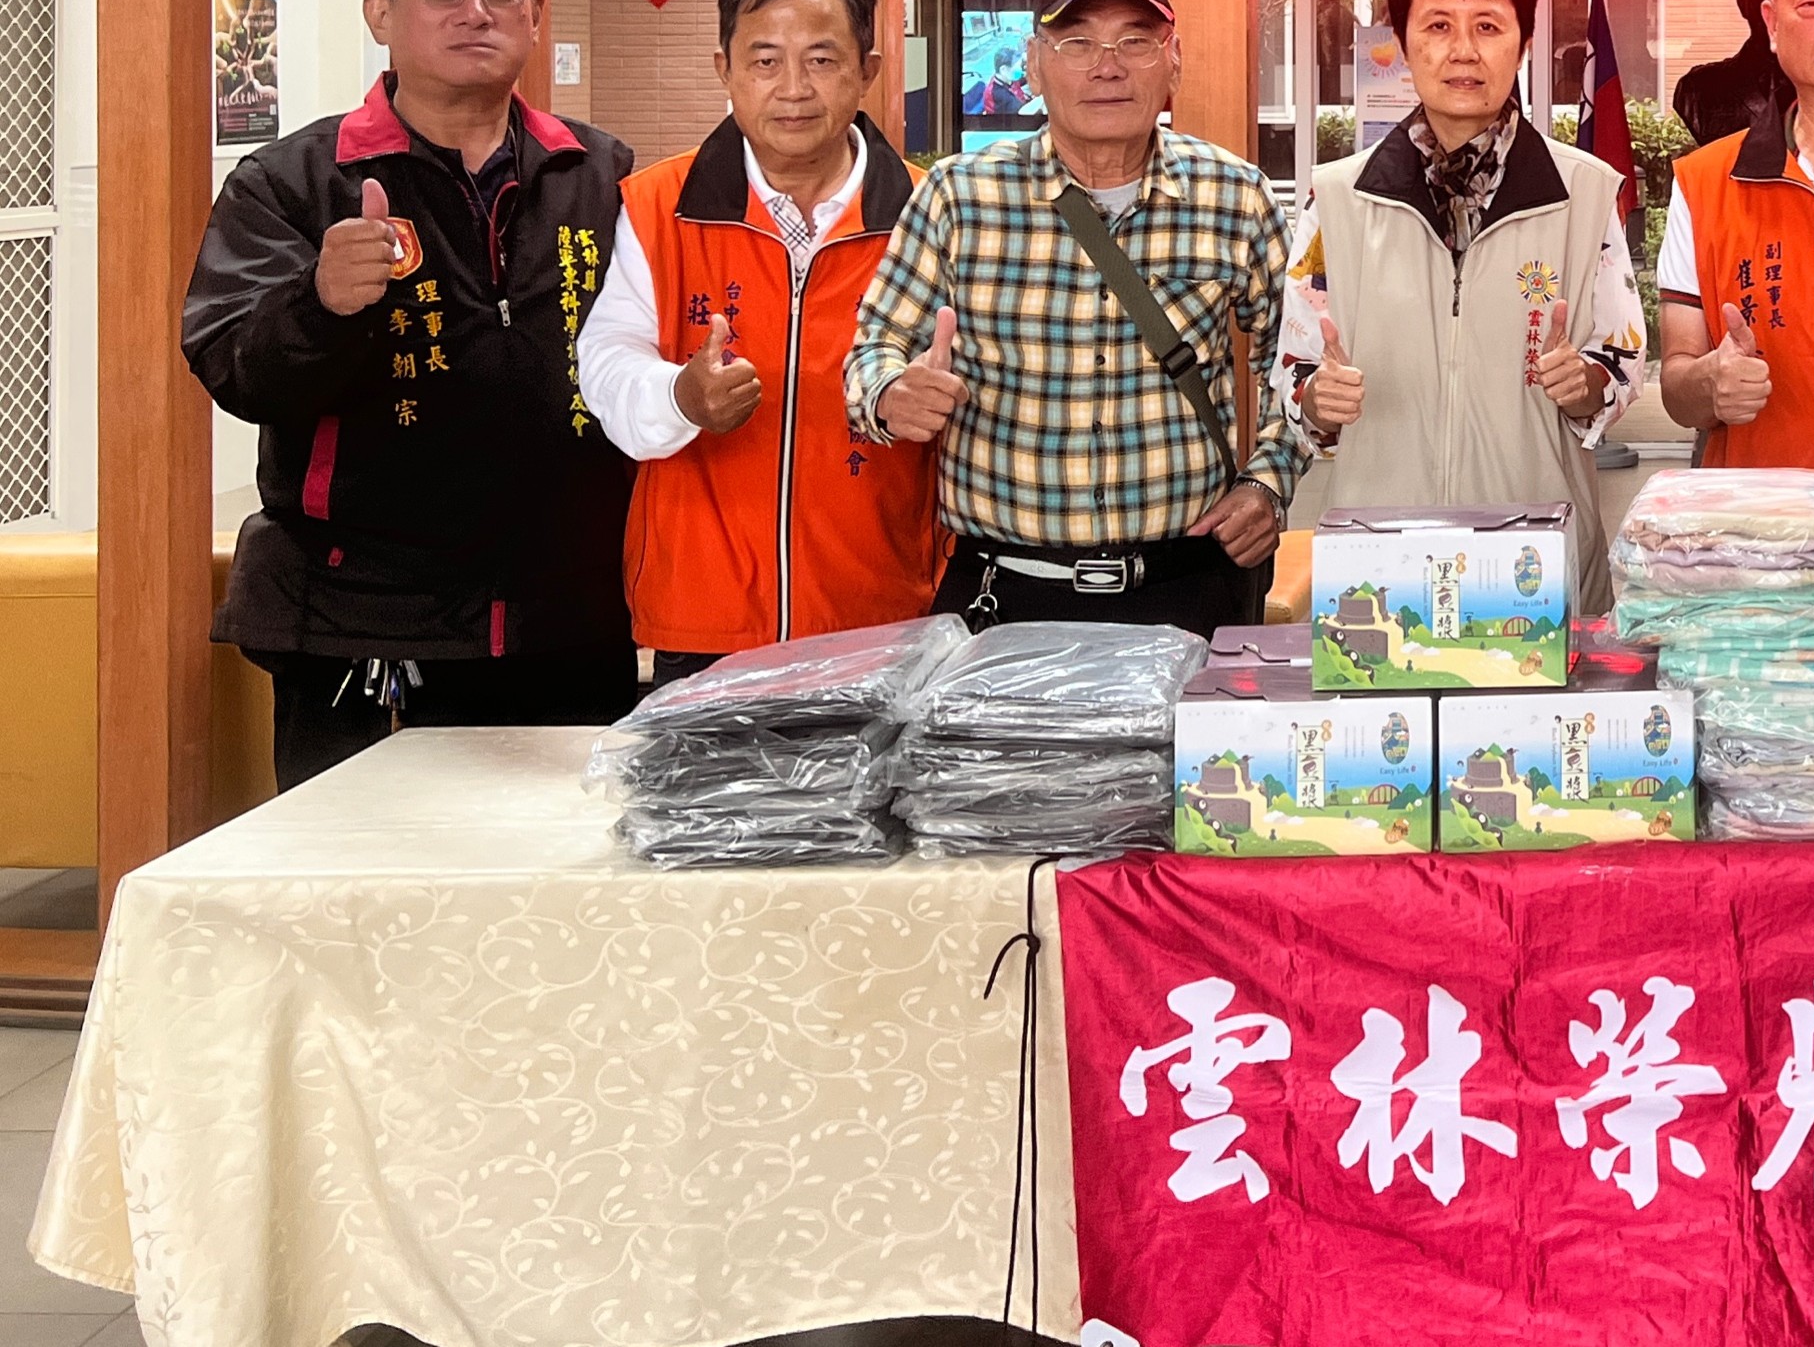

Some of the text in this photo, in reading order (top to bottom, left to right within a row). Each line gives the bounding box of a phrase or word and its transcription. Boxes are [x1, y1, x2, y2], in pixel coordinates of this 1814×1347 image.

[415, 279, 450, 372] 理事長
[1735, 258, 1764, 356] 崔景
[1765, 241, 1786, 330] 副理事長
[389, 308, 418, 427] 李朝宗
